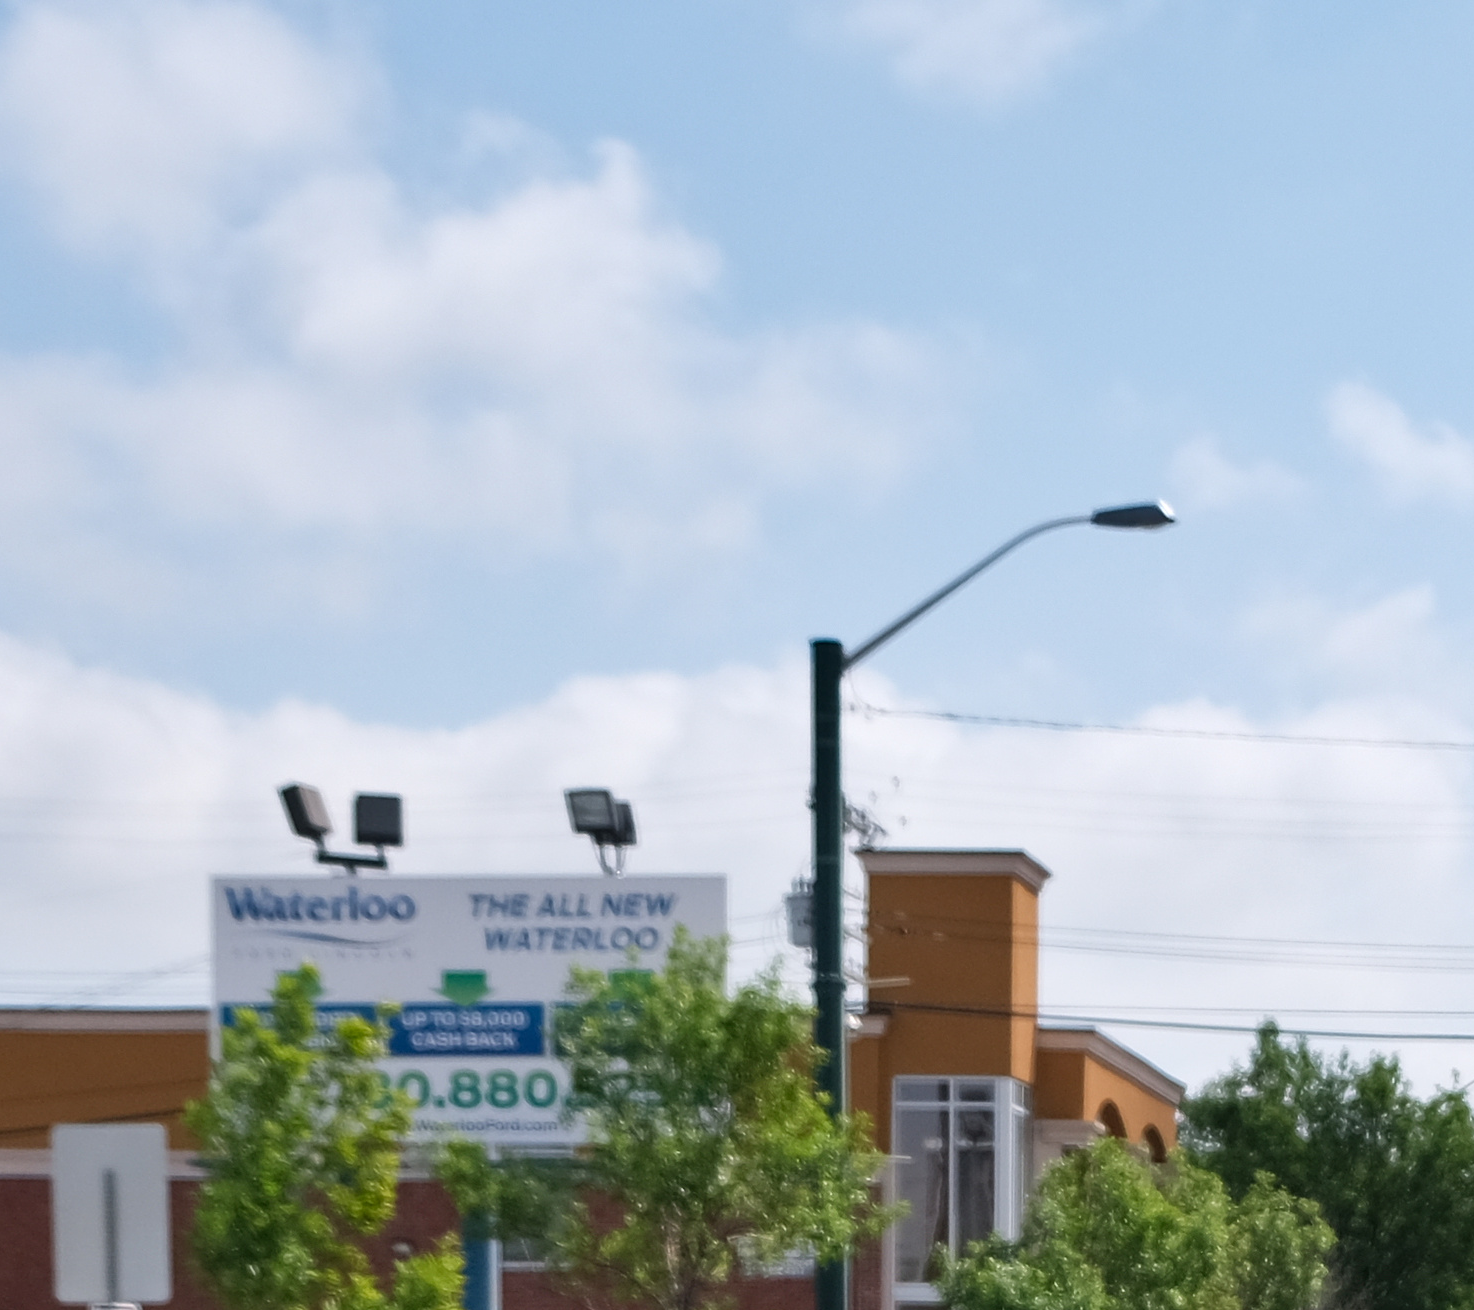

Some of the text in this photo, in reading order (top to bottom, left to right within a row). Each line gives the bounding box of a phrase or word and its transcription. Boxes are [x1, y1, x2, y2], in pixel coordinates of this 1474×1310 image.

[224, 886, 416, 921] Waterloo
[469, 893, 675, 917] THE ALL NEW
[483, 927, 660, 950] WATERLOO
[402, 1012, 427, 1026] UP
[430, 1012, 456, 1026] TO
[411, 1032, 516, 1047] CASH BACK
